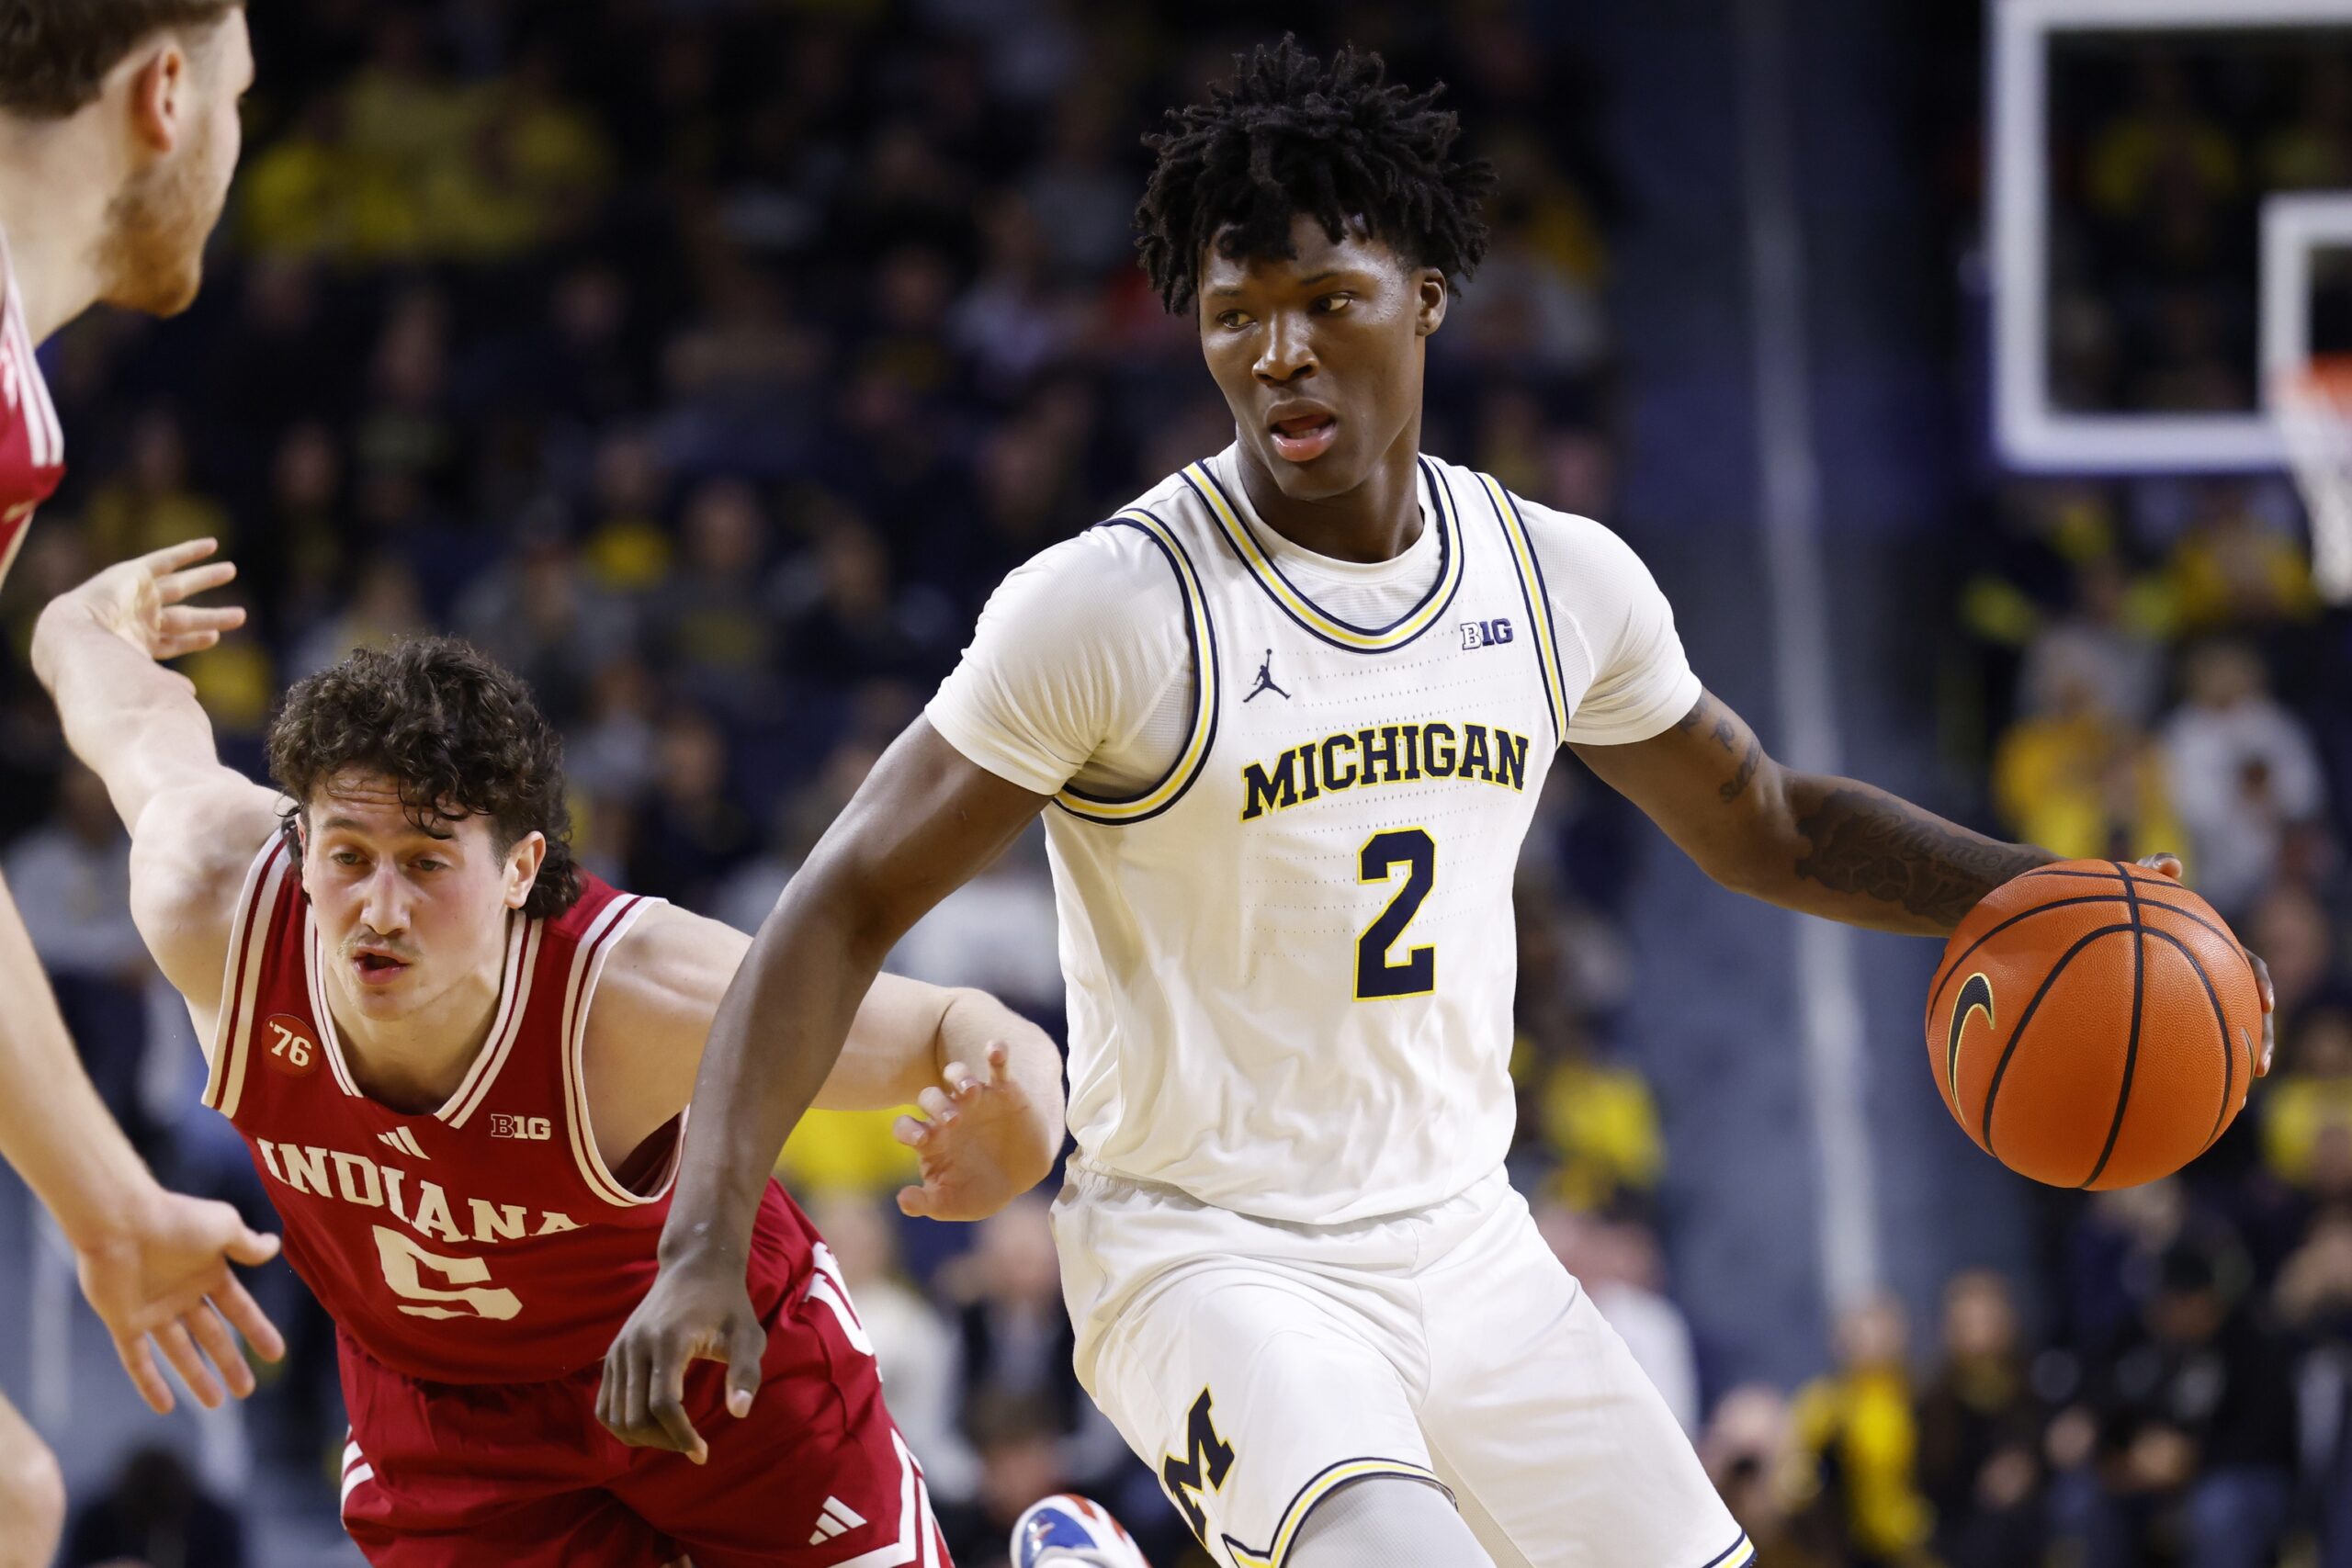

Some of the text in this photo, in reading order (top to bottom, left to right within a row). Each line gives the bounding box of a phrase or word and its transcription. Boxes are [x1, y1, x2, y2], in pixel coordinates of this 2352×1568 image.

[1239, 722, 1530, 822] MICHIGAN
[1351, 826, 1437, 1001] 2
[256, 1136, 589, 1243] INDIANA
[371, 1224, 524, 1321] 5
